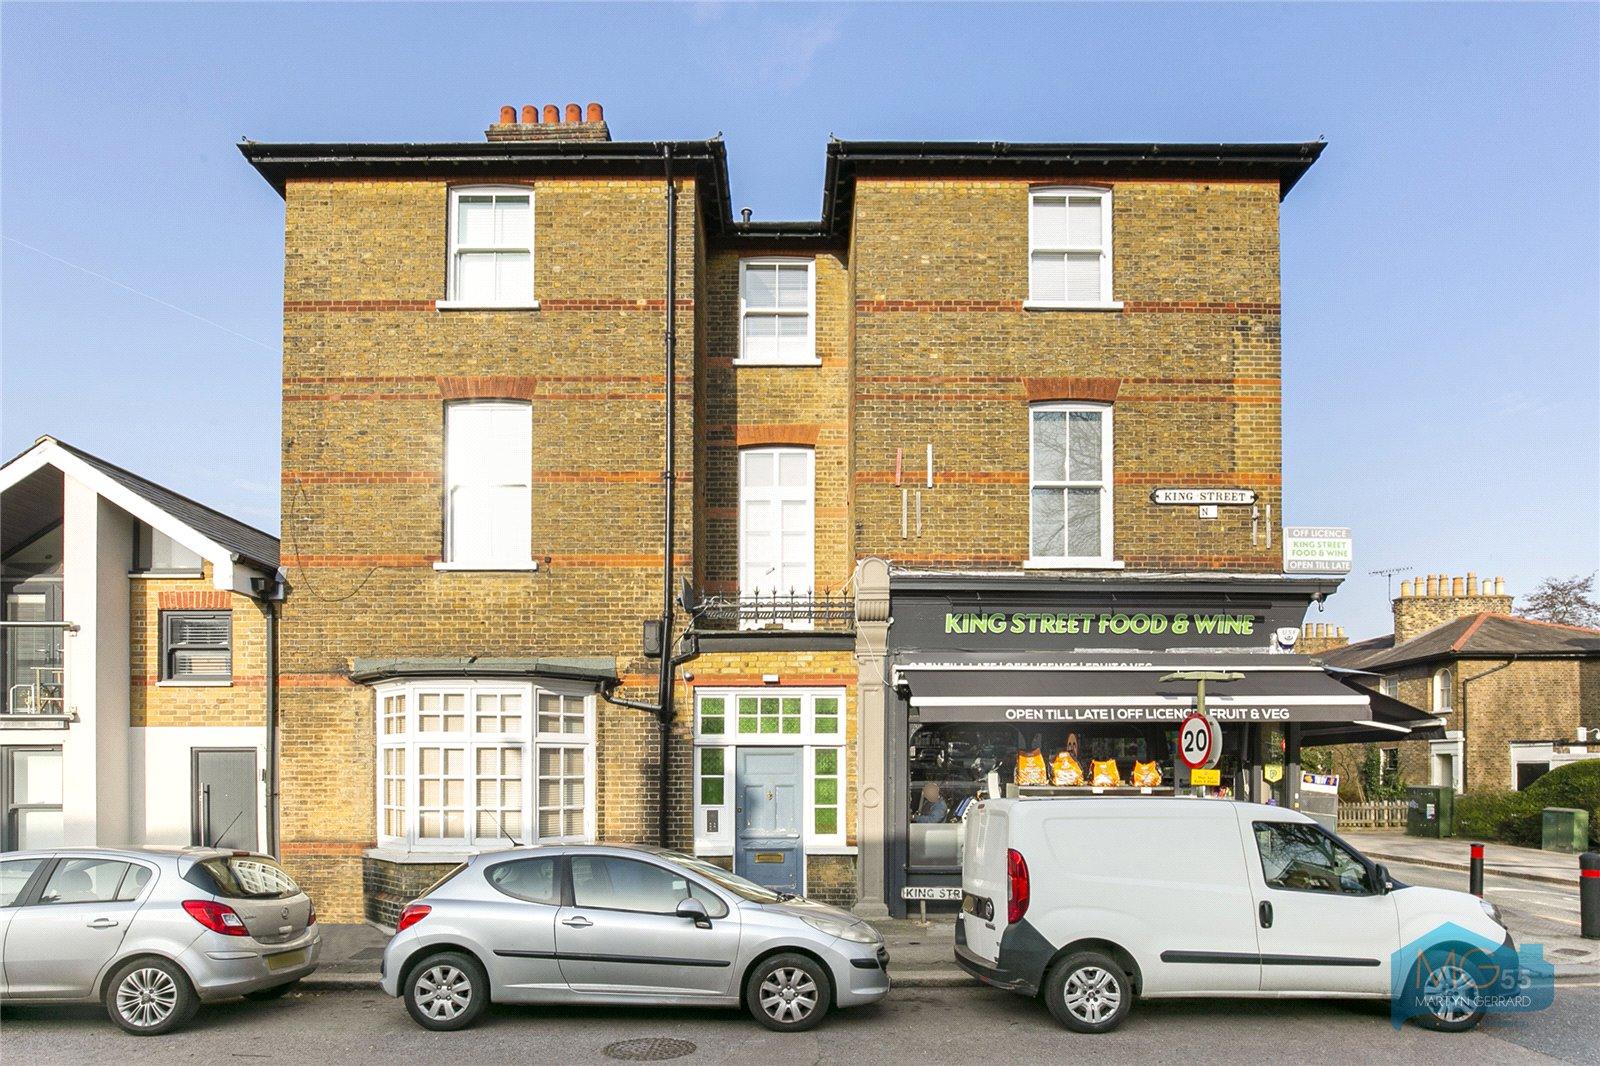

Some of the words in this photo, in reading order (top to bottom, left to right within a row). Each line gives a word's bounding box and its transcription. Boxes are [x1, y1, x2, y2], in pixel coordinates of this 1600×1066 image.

[1165, 492, 1193, 500] KING
[1200, 492, 1246, 501] STREET
[1332, 561, 1350, 570] LATE
[945, 613, 1006, 634] KING
[1010, 613, 1095, 634] STREET
[1098, 613, 1167, 634] FOOD
[1172, 613, 1190, 634] &
[1194, 614, 1255, 635] WINE
[1006, 709, 1043, 720] OPEN
[1046, 709, 1072, 720] TILL
[1075, 709, 1108, 720] LATE
[1117, 709, 1143, 720] OFF
[1209, 709, 1246, 720] FRUIT
[1250, 709, 1260, 720] &
[1262, 709, 1290, 720] VEG
[1184, 729, 1207, 752] 20
[906, 889, 934, 898] KING
